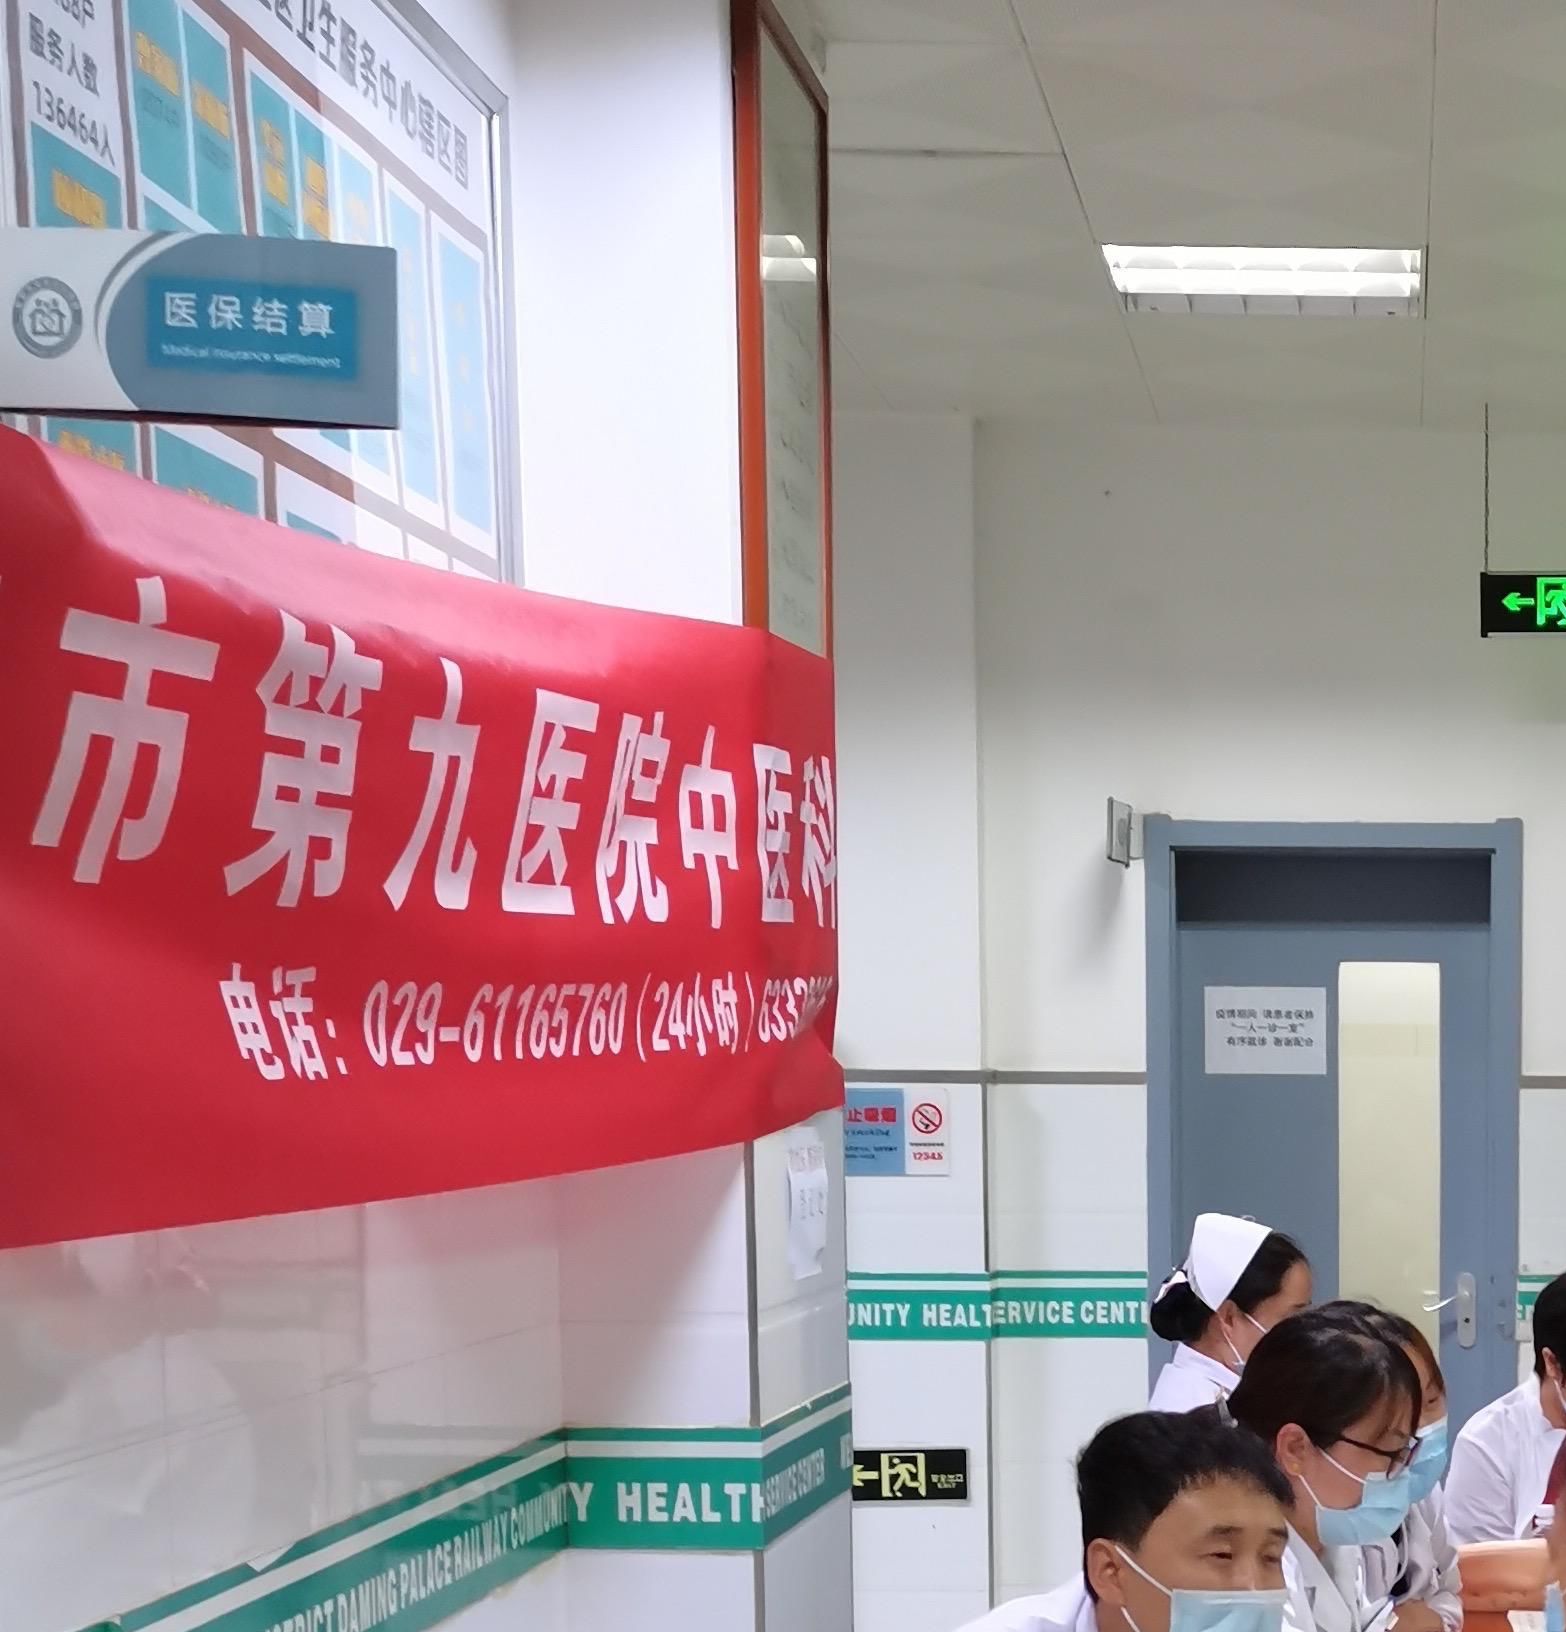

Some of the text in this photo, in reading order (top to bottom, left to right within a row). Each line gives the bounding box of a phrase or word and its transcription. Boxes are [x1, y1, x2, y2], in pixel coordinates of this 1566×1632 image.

[29, 12, 99, 96] 服务人数
[163, 291, 335, 339] 医保结算
[31, 576, 837, 929] 市第九医院中医科
[399, 1540, 453, 1609] PALACE
[453, 1510, 508, 1579] RAILWAY
